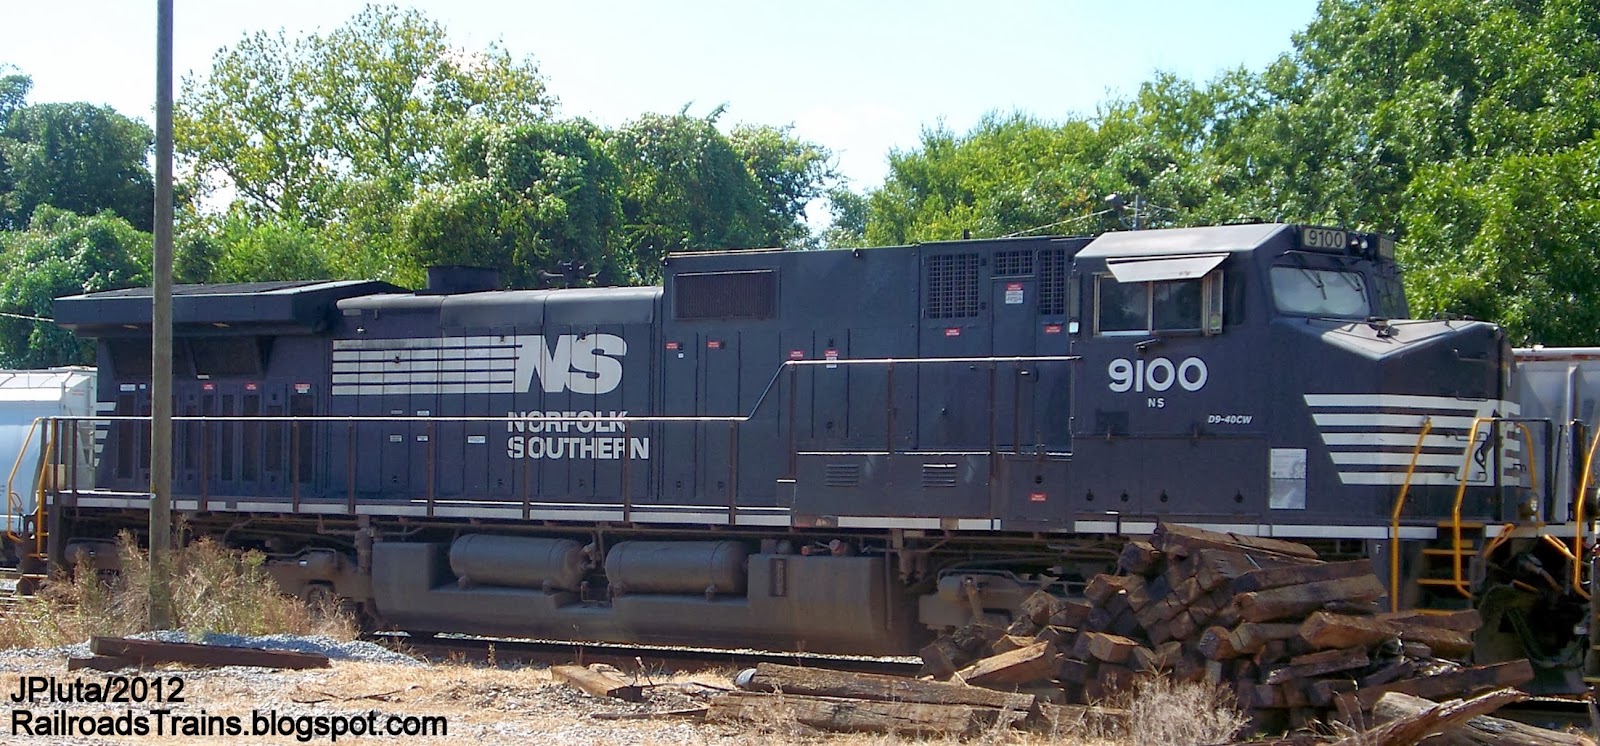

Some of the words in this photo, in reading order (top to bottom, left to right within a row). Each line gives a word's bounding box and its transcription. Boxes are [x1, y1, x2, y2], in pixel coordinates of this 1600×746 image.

[1308, 230, 1343, 248] 9100
[511, 333, 627, 394] NS
[1108, 357, 1208, 392] 9100
[1147, 397, 1165, 408] NS
[506, 410, 628, 433] NORFOLK
[1207, 414, 1253, 425] D9-40CW
[506, 436, 649, 460] SOUTHERN
